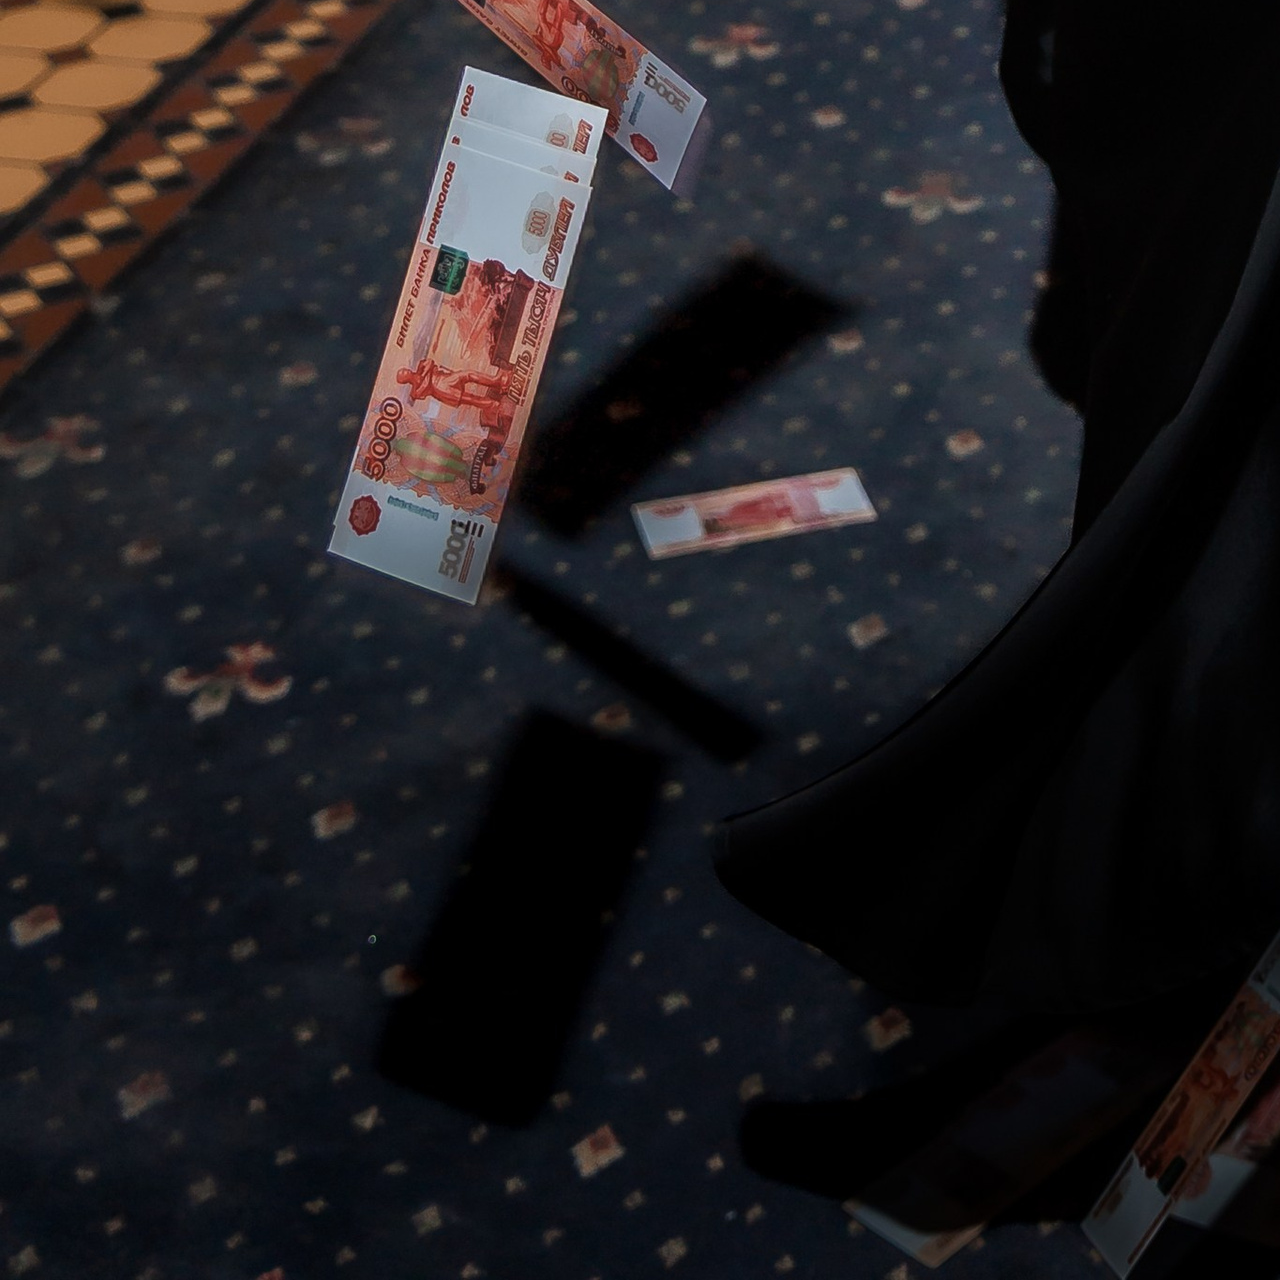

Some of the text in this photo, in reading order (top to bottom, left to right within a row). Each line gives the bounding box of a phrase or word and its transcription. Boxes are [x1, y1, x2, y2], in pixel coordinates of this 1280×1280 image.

[393, 300, 417, 345] БИЛЕТ
[409, 250, 431, 296] БАНКА
[426, 160, 457, 244] ПРИКОЛОВ
[527, 209, 549, 236] 5000
[506, 351, 533, 401] ПЯТЬ
[521, 285, 550, 344] ТЫСЯЧ
[543, 197, 576, 282] ДУБЛЕЙ
[360, 398, 405, 480] 5000
[438, 521, 468, 577] 5000
